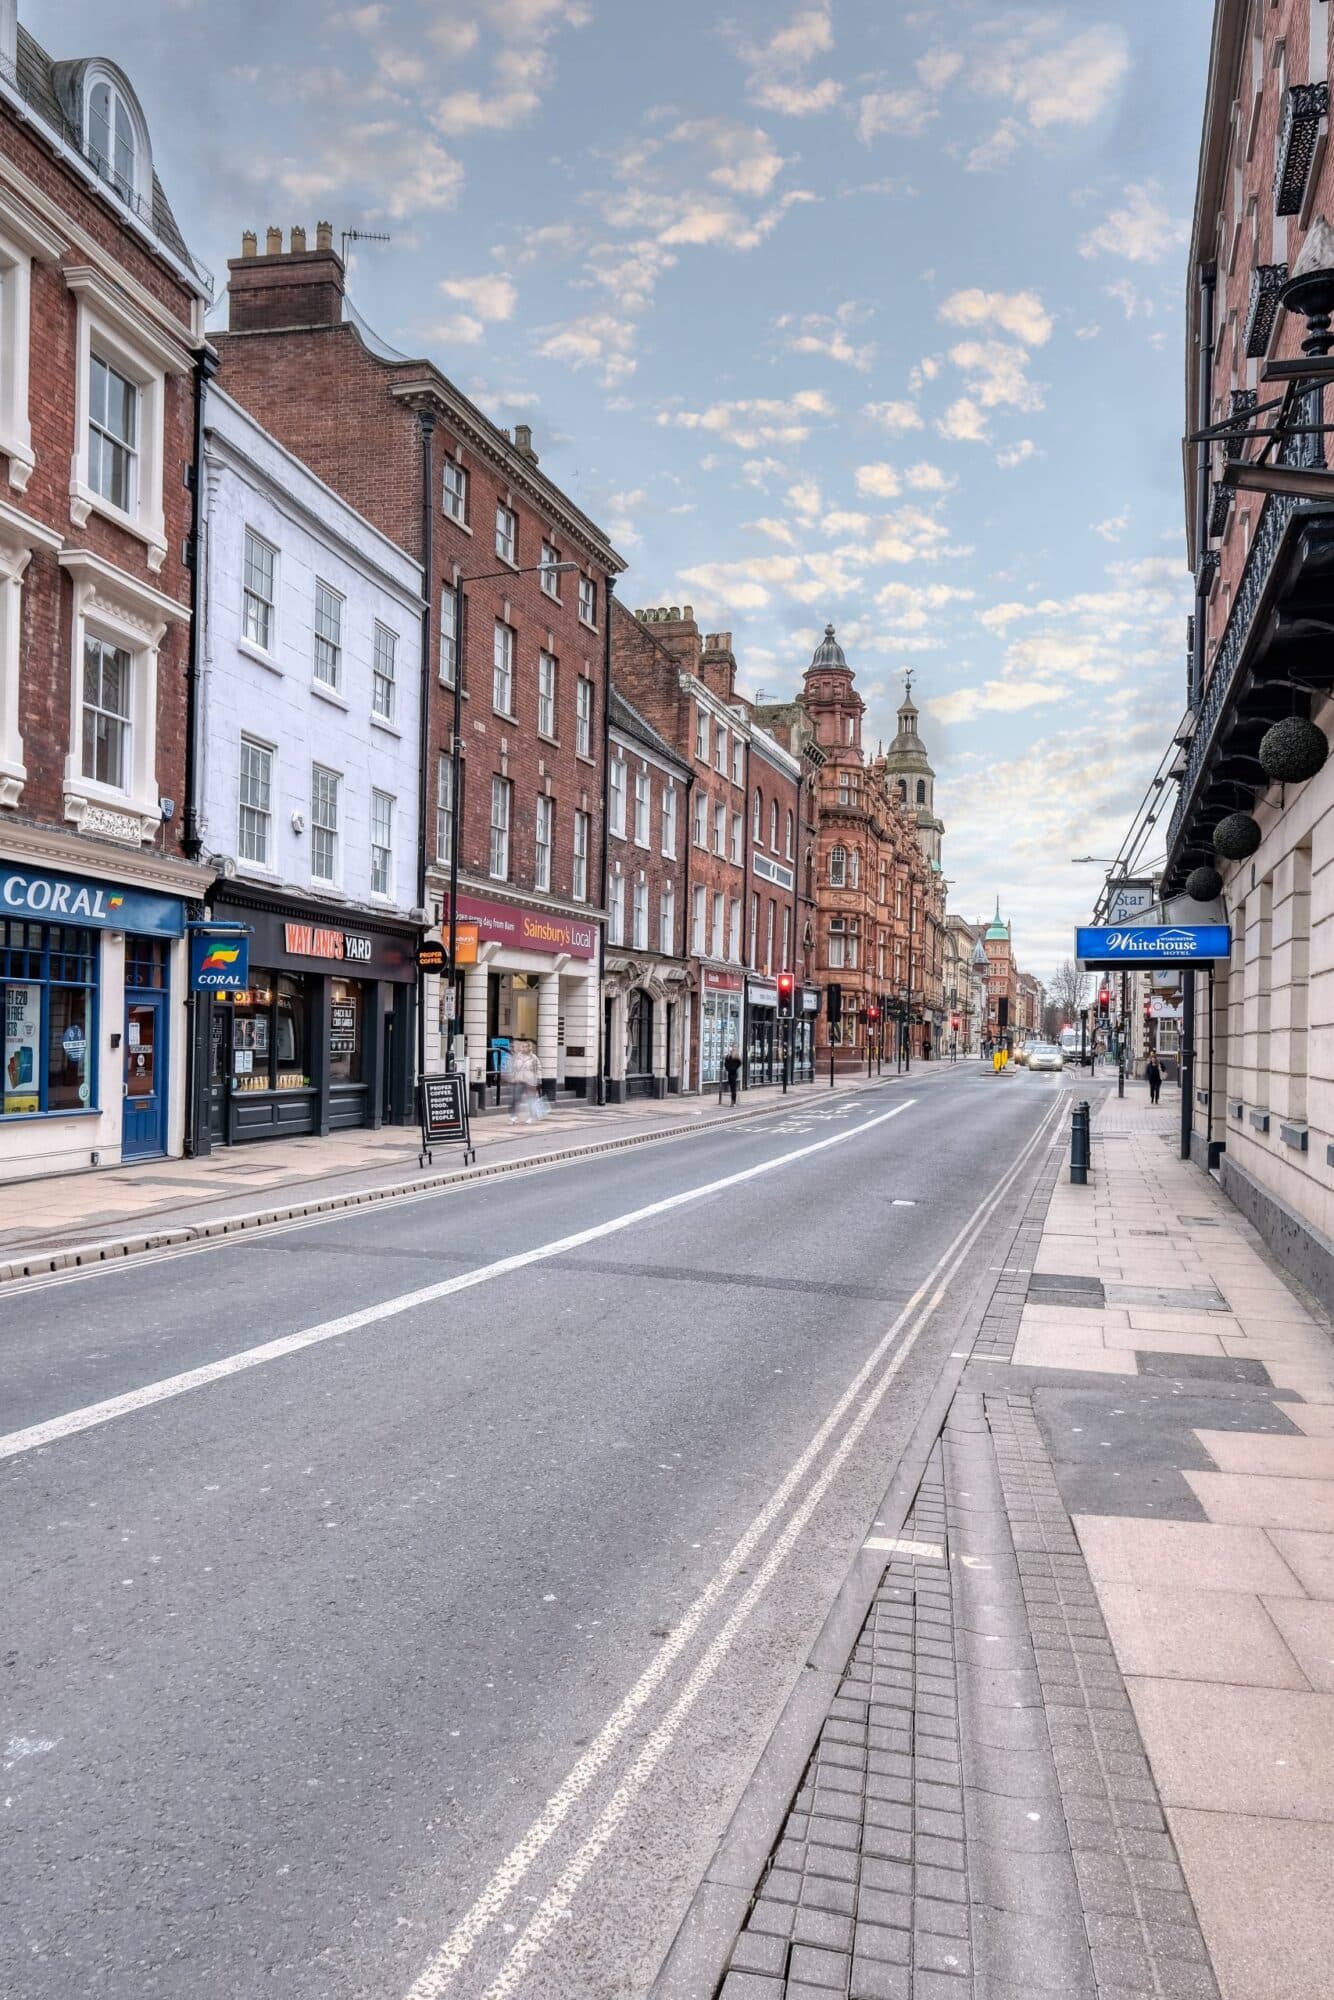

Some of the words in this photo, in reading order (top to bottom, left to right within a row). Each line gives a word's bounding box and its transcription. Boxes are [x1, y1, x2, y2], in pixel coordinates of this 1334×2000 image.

[3, 876, 107, 919] CORAL
[1115, 892, 1145, 906] Star
[483, 916, 492, 929] day
[523, 917, 571, 947] Sainsbury's
[571, 927, 591, 948] Local
[285, 923, 344, 960] WAYLAND'S
[345, 935, 372, 960] YARD
[1105, 931, 1198, 951] Whitehouse
[198, 975, 241, 985] CORAL
